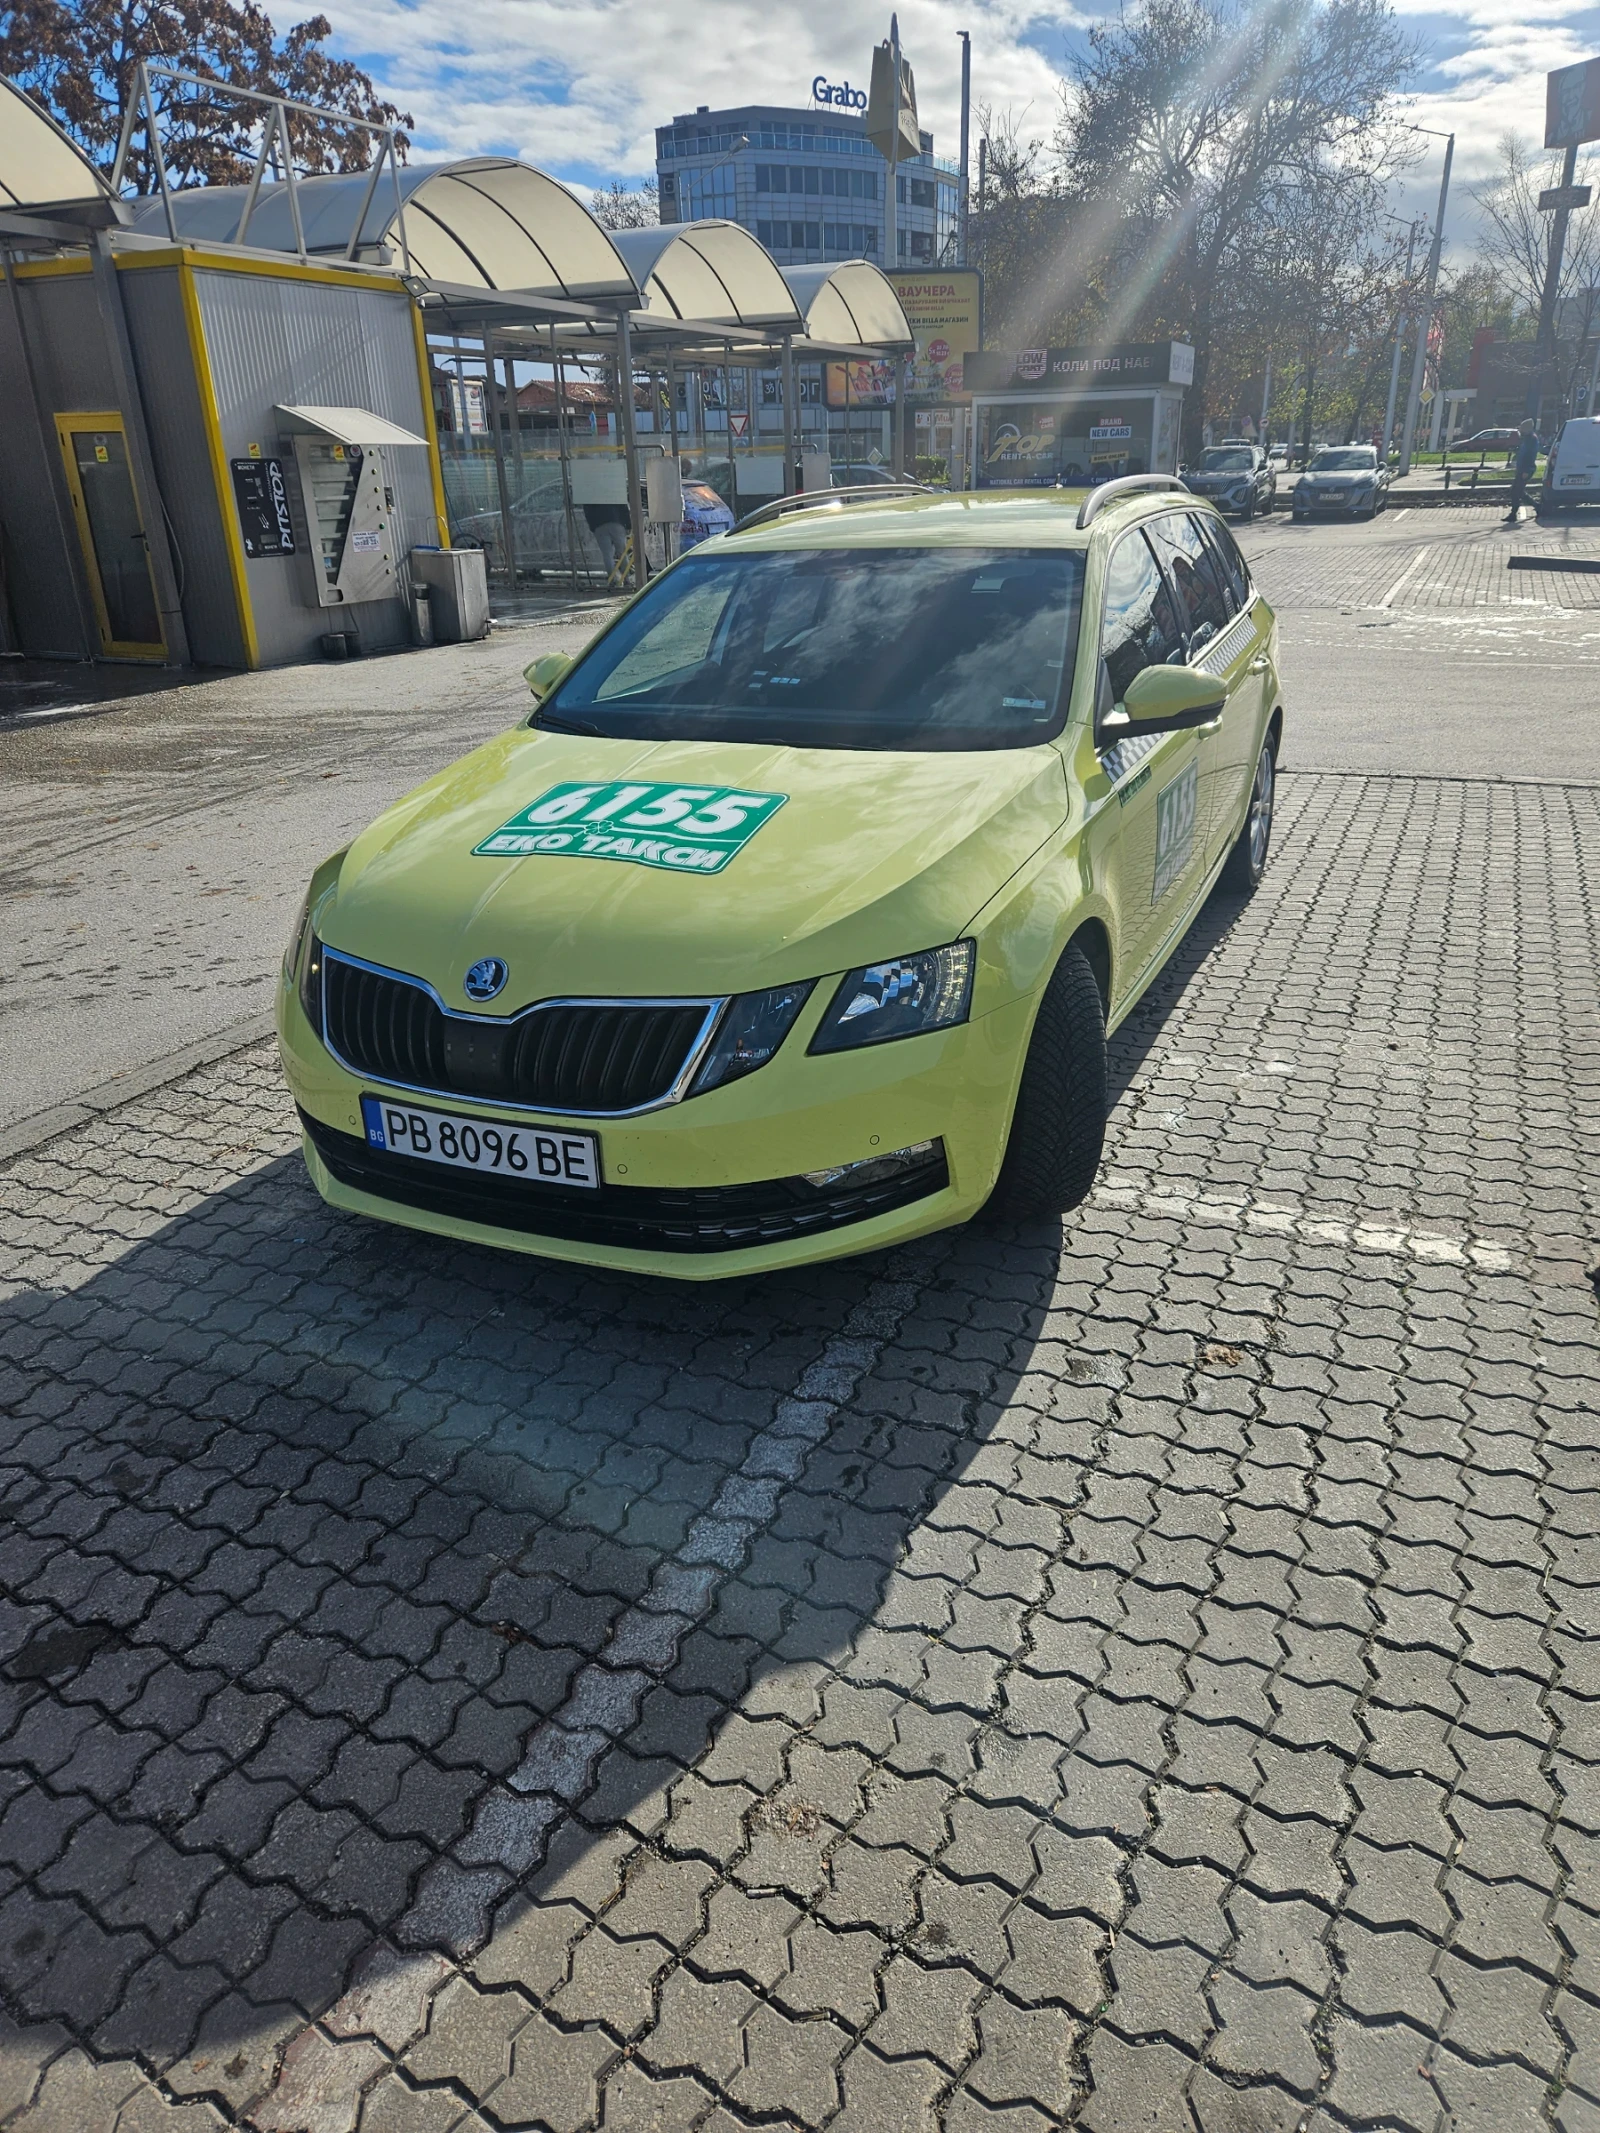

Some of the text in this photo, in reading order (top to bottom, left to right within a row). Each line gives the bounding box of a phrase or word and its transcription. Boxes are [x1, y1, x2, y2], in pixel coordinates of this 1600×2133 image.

[812, 75, 867, 109] Grabo
[898, 285, 955, 297] ВАУЧЕРА
[1017, 353, 1042, 364] LOW
[1053, 360, 1089, 373] КОЛИ
[1093, 358, 1121, 371] ПОД
[1092, 427, 1130, 438] NEW CARS
[1100, 418, 1122, 426] BRAND
[986, 434, 1056, 464] TOP
[1001, 452, 1054, 460] RENT-A-CAR
[989, 478, 1013, 486] NATIONAL
[269, 461, 294, 549] PITSTOP
[527, 786, 771, 834] 6155
[1159, 768, 1197, 857] 6155
[481, 833, 728, 869] ЕКО ТАКСИ
[369, 1109, 589, 1181] BG PB 8096 BE
